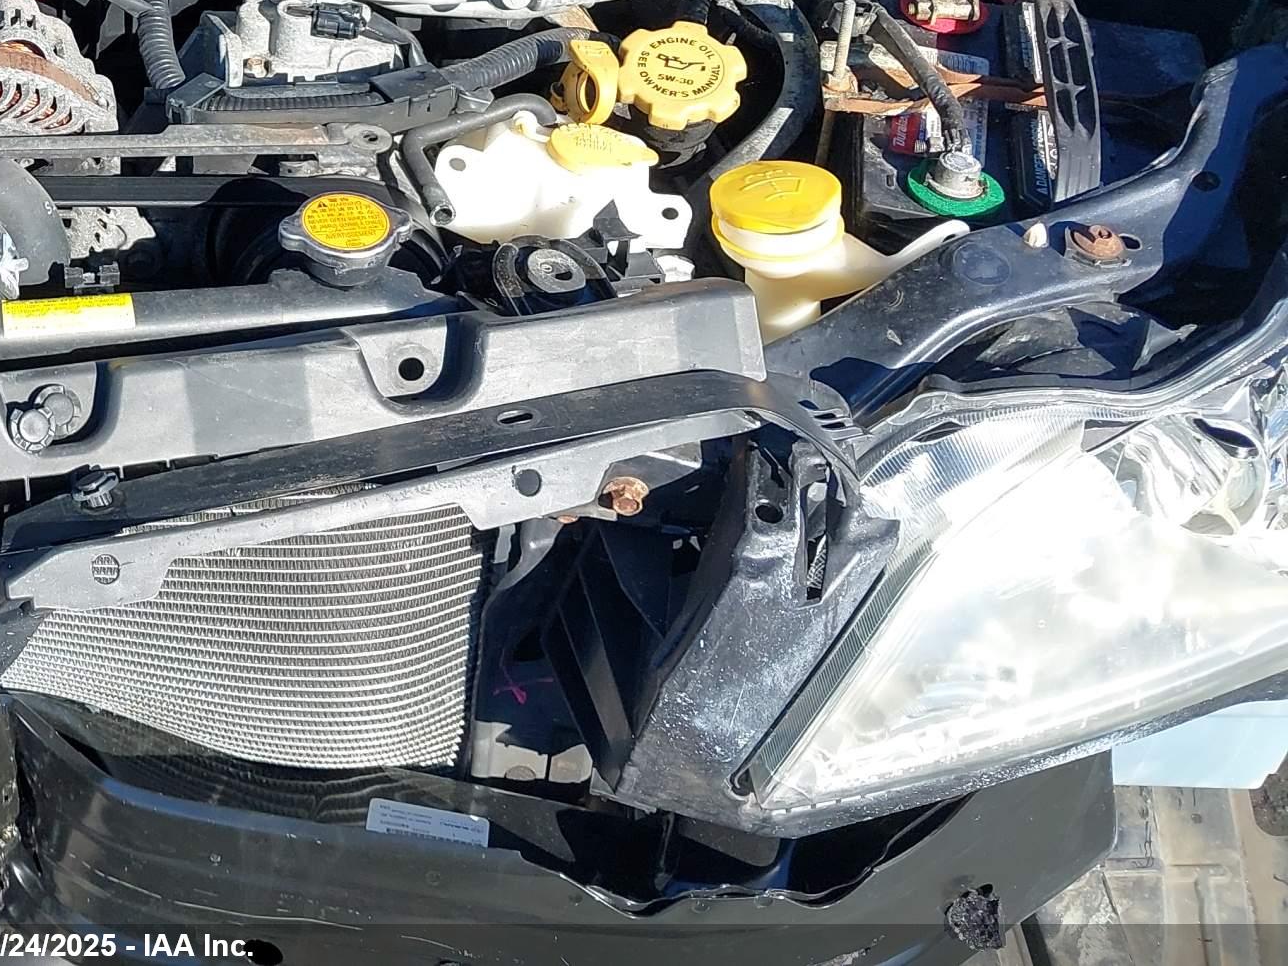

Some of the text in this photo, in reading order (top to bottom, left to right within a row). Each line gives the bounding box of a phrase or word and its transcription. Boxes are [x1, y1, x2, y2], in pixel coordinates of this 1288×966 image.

[649, 37, 715, 60] ENGINE OIL
[637, 50, 721, 98] SEE OWNER'S MANUAL
[657, 73, 694, 85] 5W-30
